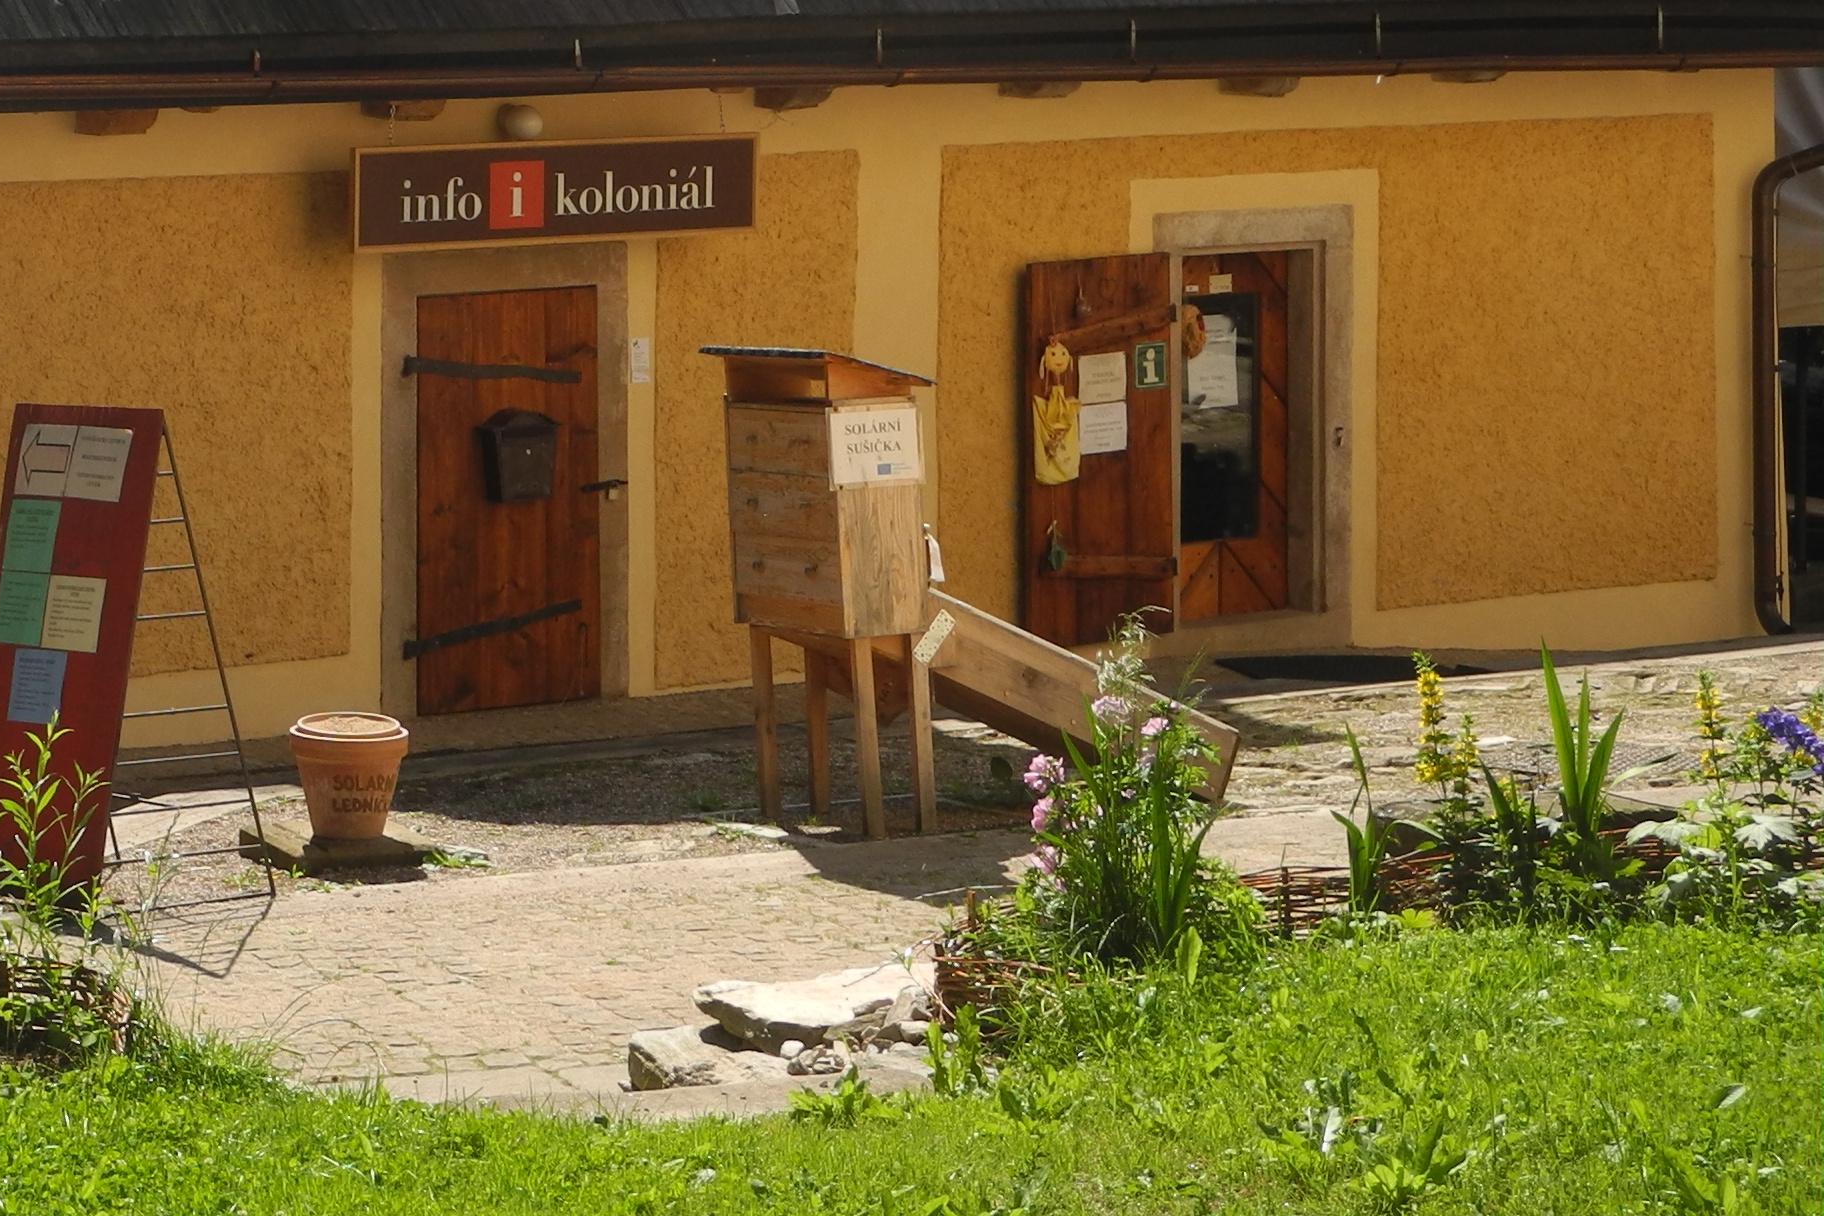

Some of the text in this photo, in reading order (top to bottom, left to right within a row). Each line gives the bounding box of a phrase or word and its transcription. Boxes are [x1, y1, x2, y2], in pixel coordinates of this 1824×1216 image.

[401, 165, 716, 223] info i koloniál
[844, 417, 901, 435] SOLÁRNÍ
[846, 438, 902, 454] SUŠIČKA
